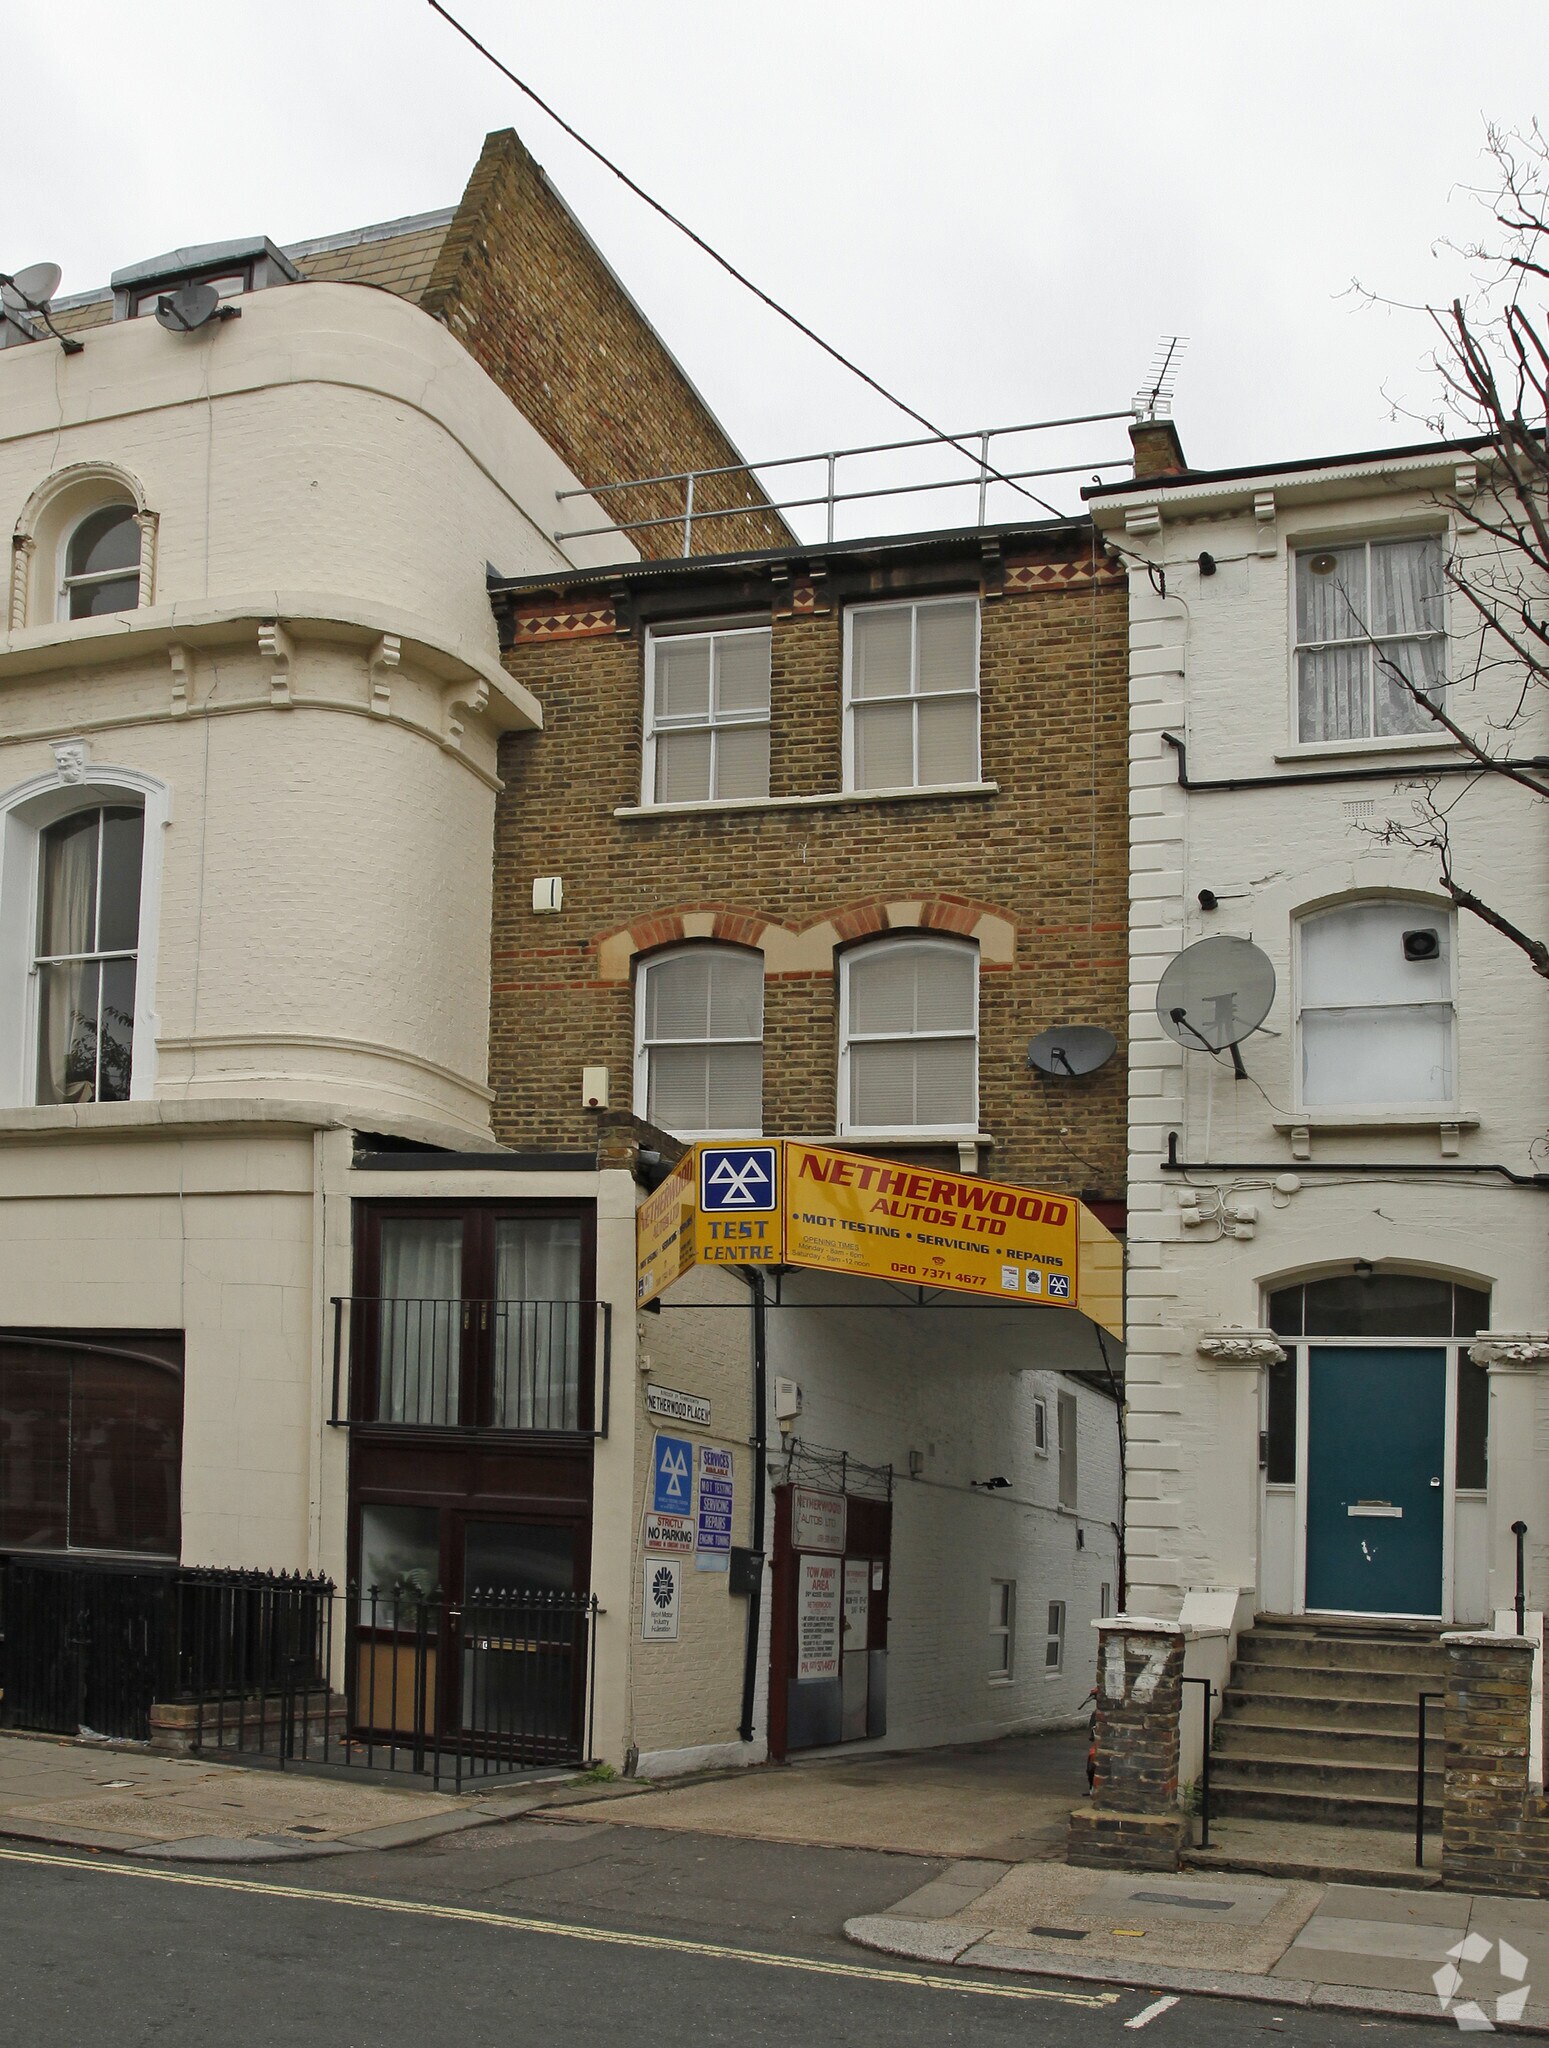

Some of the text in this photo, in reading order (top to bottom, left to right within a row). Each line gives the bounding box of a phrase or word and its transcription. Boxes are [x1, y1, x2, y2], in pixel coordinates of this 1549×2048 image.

[798, 1153, 1069, 1226] NETHERWOOD
[870, 1198, 1007, 1236] AUTOS LTD
[707, 1220, 769, 1240] TEST
[802, 1213, 900, 1239] MOT TESTING
[798, 1242, 825, 1254] Monday
[802, 1235, 860, 1251] OPENING TIMES
[917, 1233, 990, 1254] SERVICING
[703, 1245, 774, 1260] CENTRE
[791, 1249, 821, 1261] Saturday
[1006, 1248, 1063, 1267] REPAIRS
[890, 1262, 987, 1286] 020 7371 4677
[648, 1395, 687, 1416] NETHERWOOD
[687, 1404, 706, 1421] PLACE
[703, 1450, 730, 1469] SERVICES
[714, 1482, 731, 1496] TESTING
[703, 1497, 729, 1513] SERVICING
[797, 1494, 842, 1515] NETHERWOOD
[657, 1516, 684, 1529] STRICTLY
[704, 1515, 726, 1530] REPAIRS
[801, 1513, 837, 1528] AUTOS LTD
[647, 1526, 692, 1543] NO PARKING
[806, 1566, 836, 1579] TOW AWAY
[811, 1579, 830, 1591] AREA
[1104, 1635, 1174, 1704] 17
